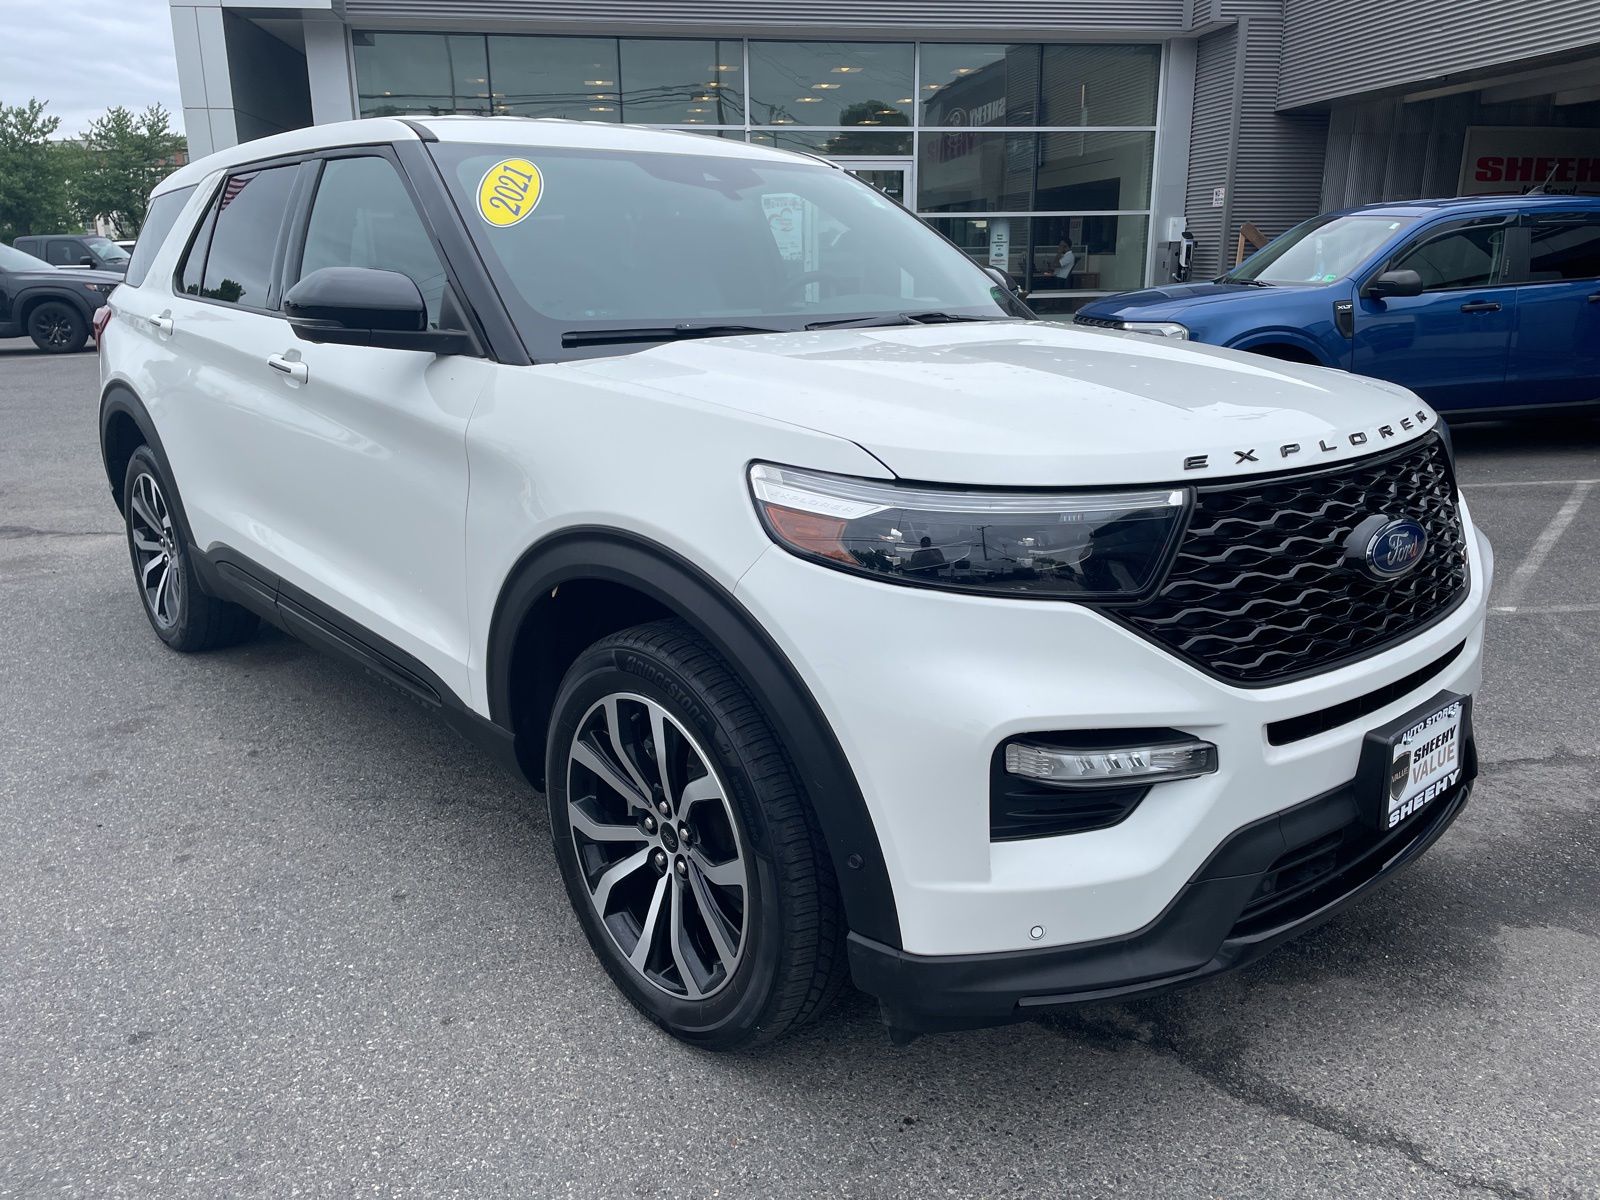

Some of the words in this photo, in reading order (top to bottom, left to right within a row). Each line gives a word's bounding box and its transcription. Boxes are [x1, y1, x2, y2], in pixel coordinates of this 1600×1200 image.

[489, 165, 533, 216] 2021
[1183, 410, 1427, 471] EXPLORER
[1387, 530, 1418, 566] Ford
[1401, 721, 1424, 743] AUTO
[1425, 701, 1460, 728] STORES
[1412, 742, 1455, 785] VALUE
[1413, 724, 1457, 764] SHEEHY
[1391, 766, 1409, 782] VALUE
[1388, 768, 1461, 828] SHEEHY
